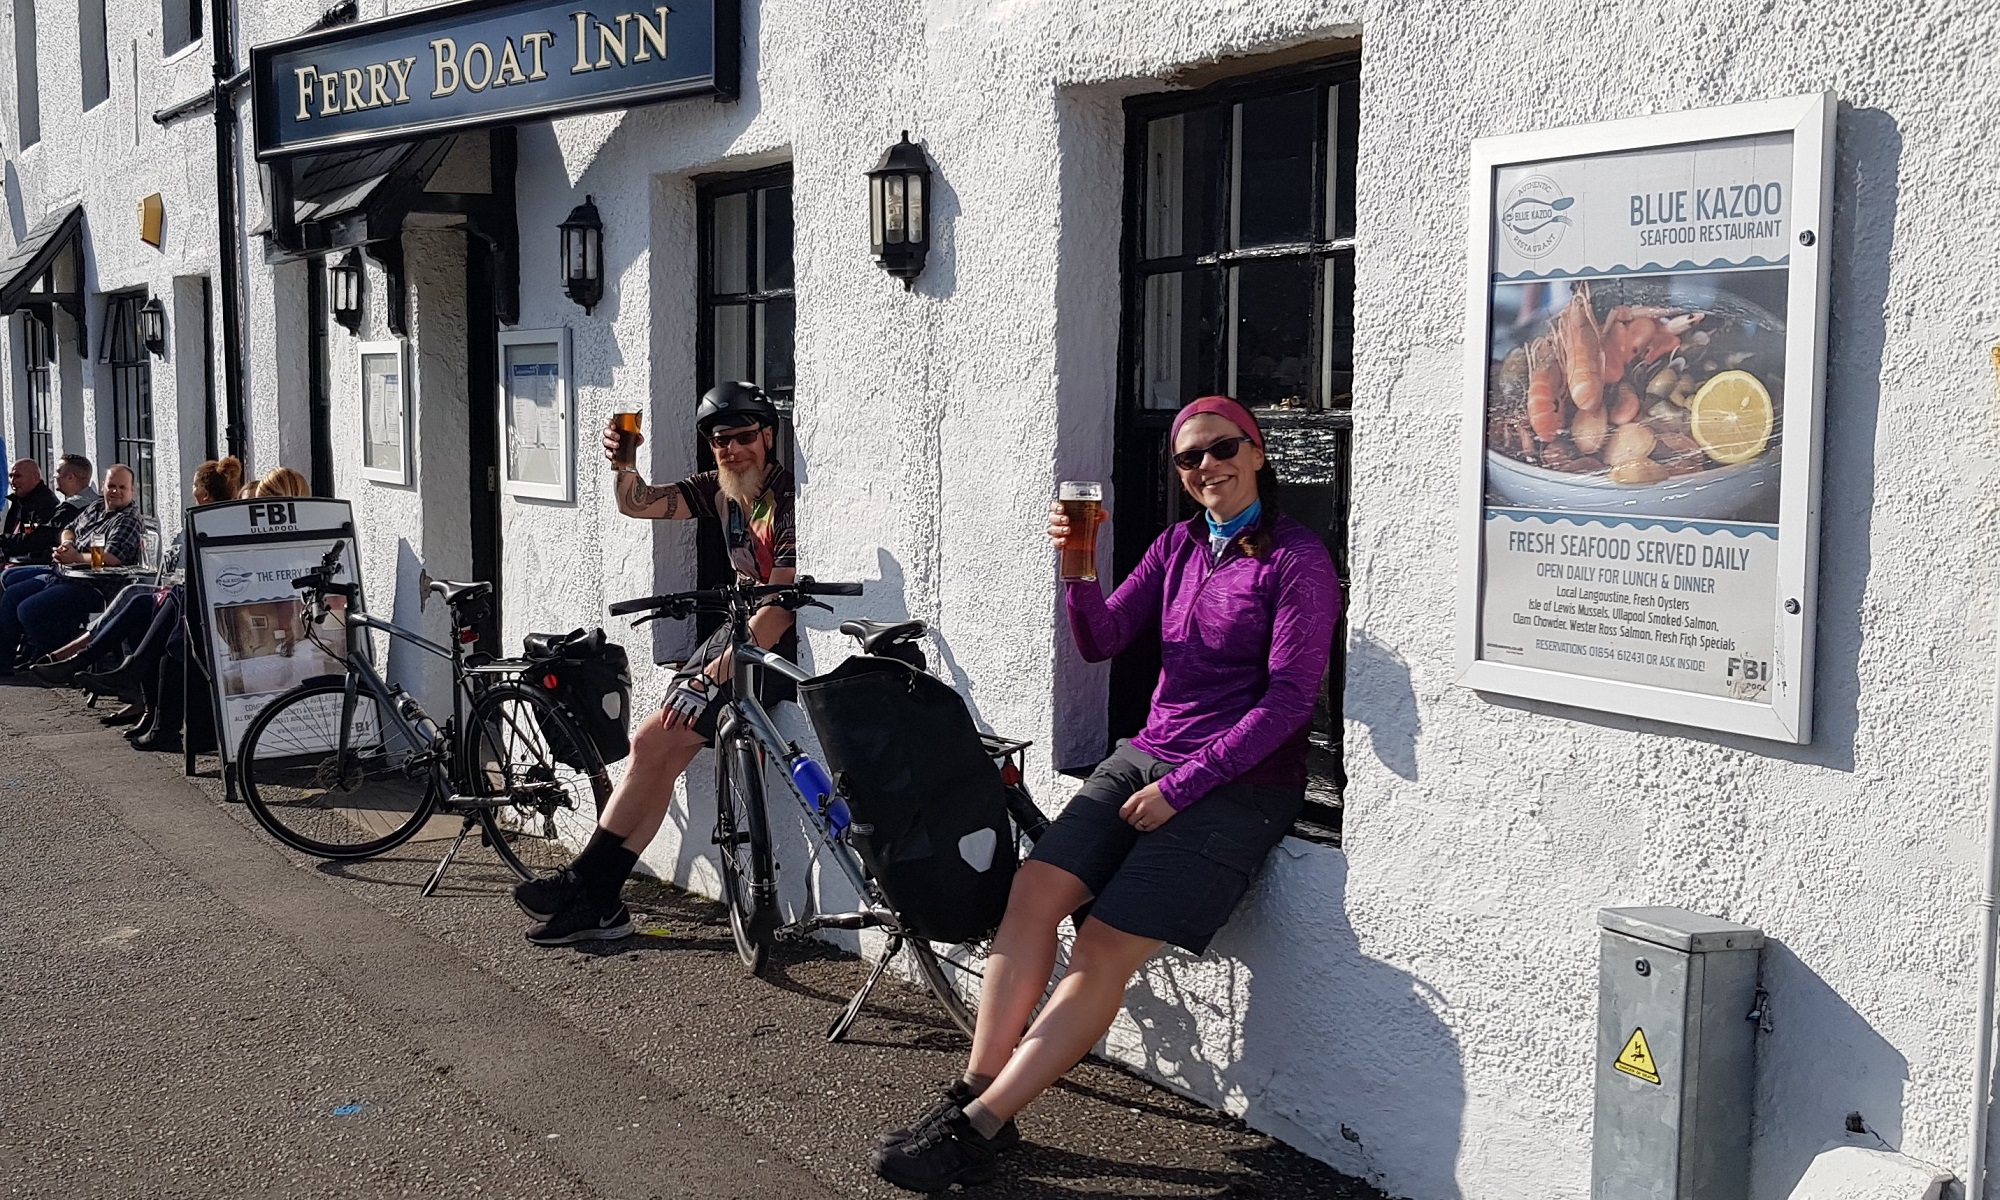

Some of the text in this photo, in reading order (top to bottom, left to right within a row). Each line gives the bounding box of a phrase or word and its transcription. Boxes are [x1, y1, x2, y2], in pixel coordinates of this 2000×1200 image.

[294, 6, 671, 122] FERRY BOAT INN
[1517, 181, 1552, 197] AUTHENTIC
[1515, 209, 1553, 221] BLUE KAZOO
[1631, 182, 1782, 226] BLUE KAZOO
[1513, 233, 1556, 252] RESTAURANT
[1640, 219, 1782, 246] SEAFOOD RESTAURANT
[249, 502, 297, 526] FBI
[251, 525, 300, 533] ULLAPOOL
[1509, 531, 1750, 571] FRESH SEAFOOD SERVED DAILY
[256, 571, 273, 582] THE
[1537, 562, 1715, 594] OPEN DAILY FOR LUNCH & DINNER
[1556, 585, 1690, 611] Local Langoustine, Fresh Oysters
[1528, 598, 1719, 632] Isle of Lewis Mussels, Ullapool Smoked Salmon,
[1512, 612, 1531, 625] Clam
[1569, 619, 1596, 633] Wester
[1598, 623, 1617, 636] Ross
[1655, 630, 1677, 644] Fresh
[1680, 633, 1697, 647] Fish
[1700, 635, 1736, 651] Specials
[1535, 639, 1587, 655] RESERVATIONS
[1589, 646, 1614, 659] 01854
[1617, 650, 1644, 663] 612431
[1646, 654, 1657, 665] OR
[1660, 656, 1675, 667] ASK
[1677, 658, 1706, 672] INSIDE!
[1728, 657, 1767, 681] FBI
